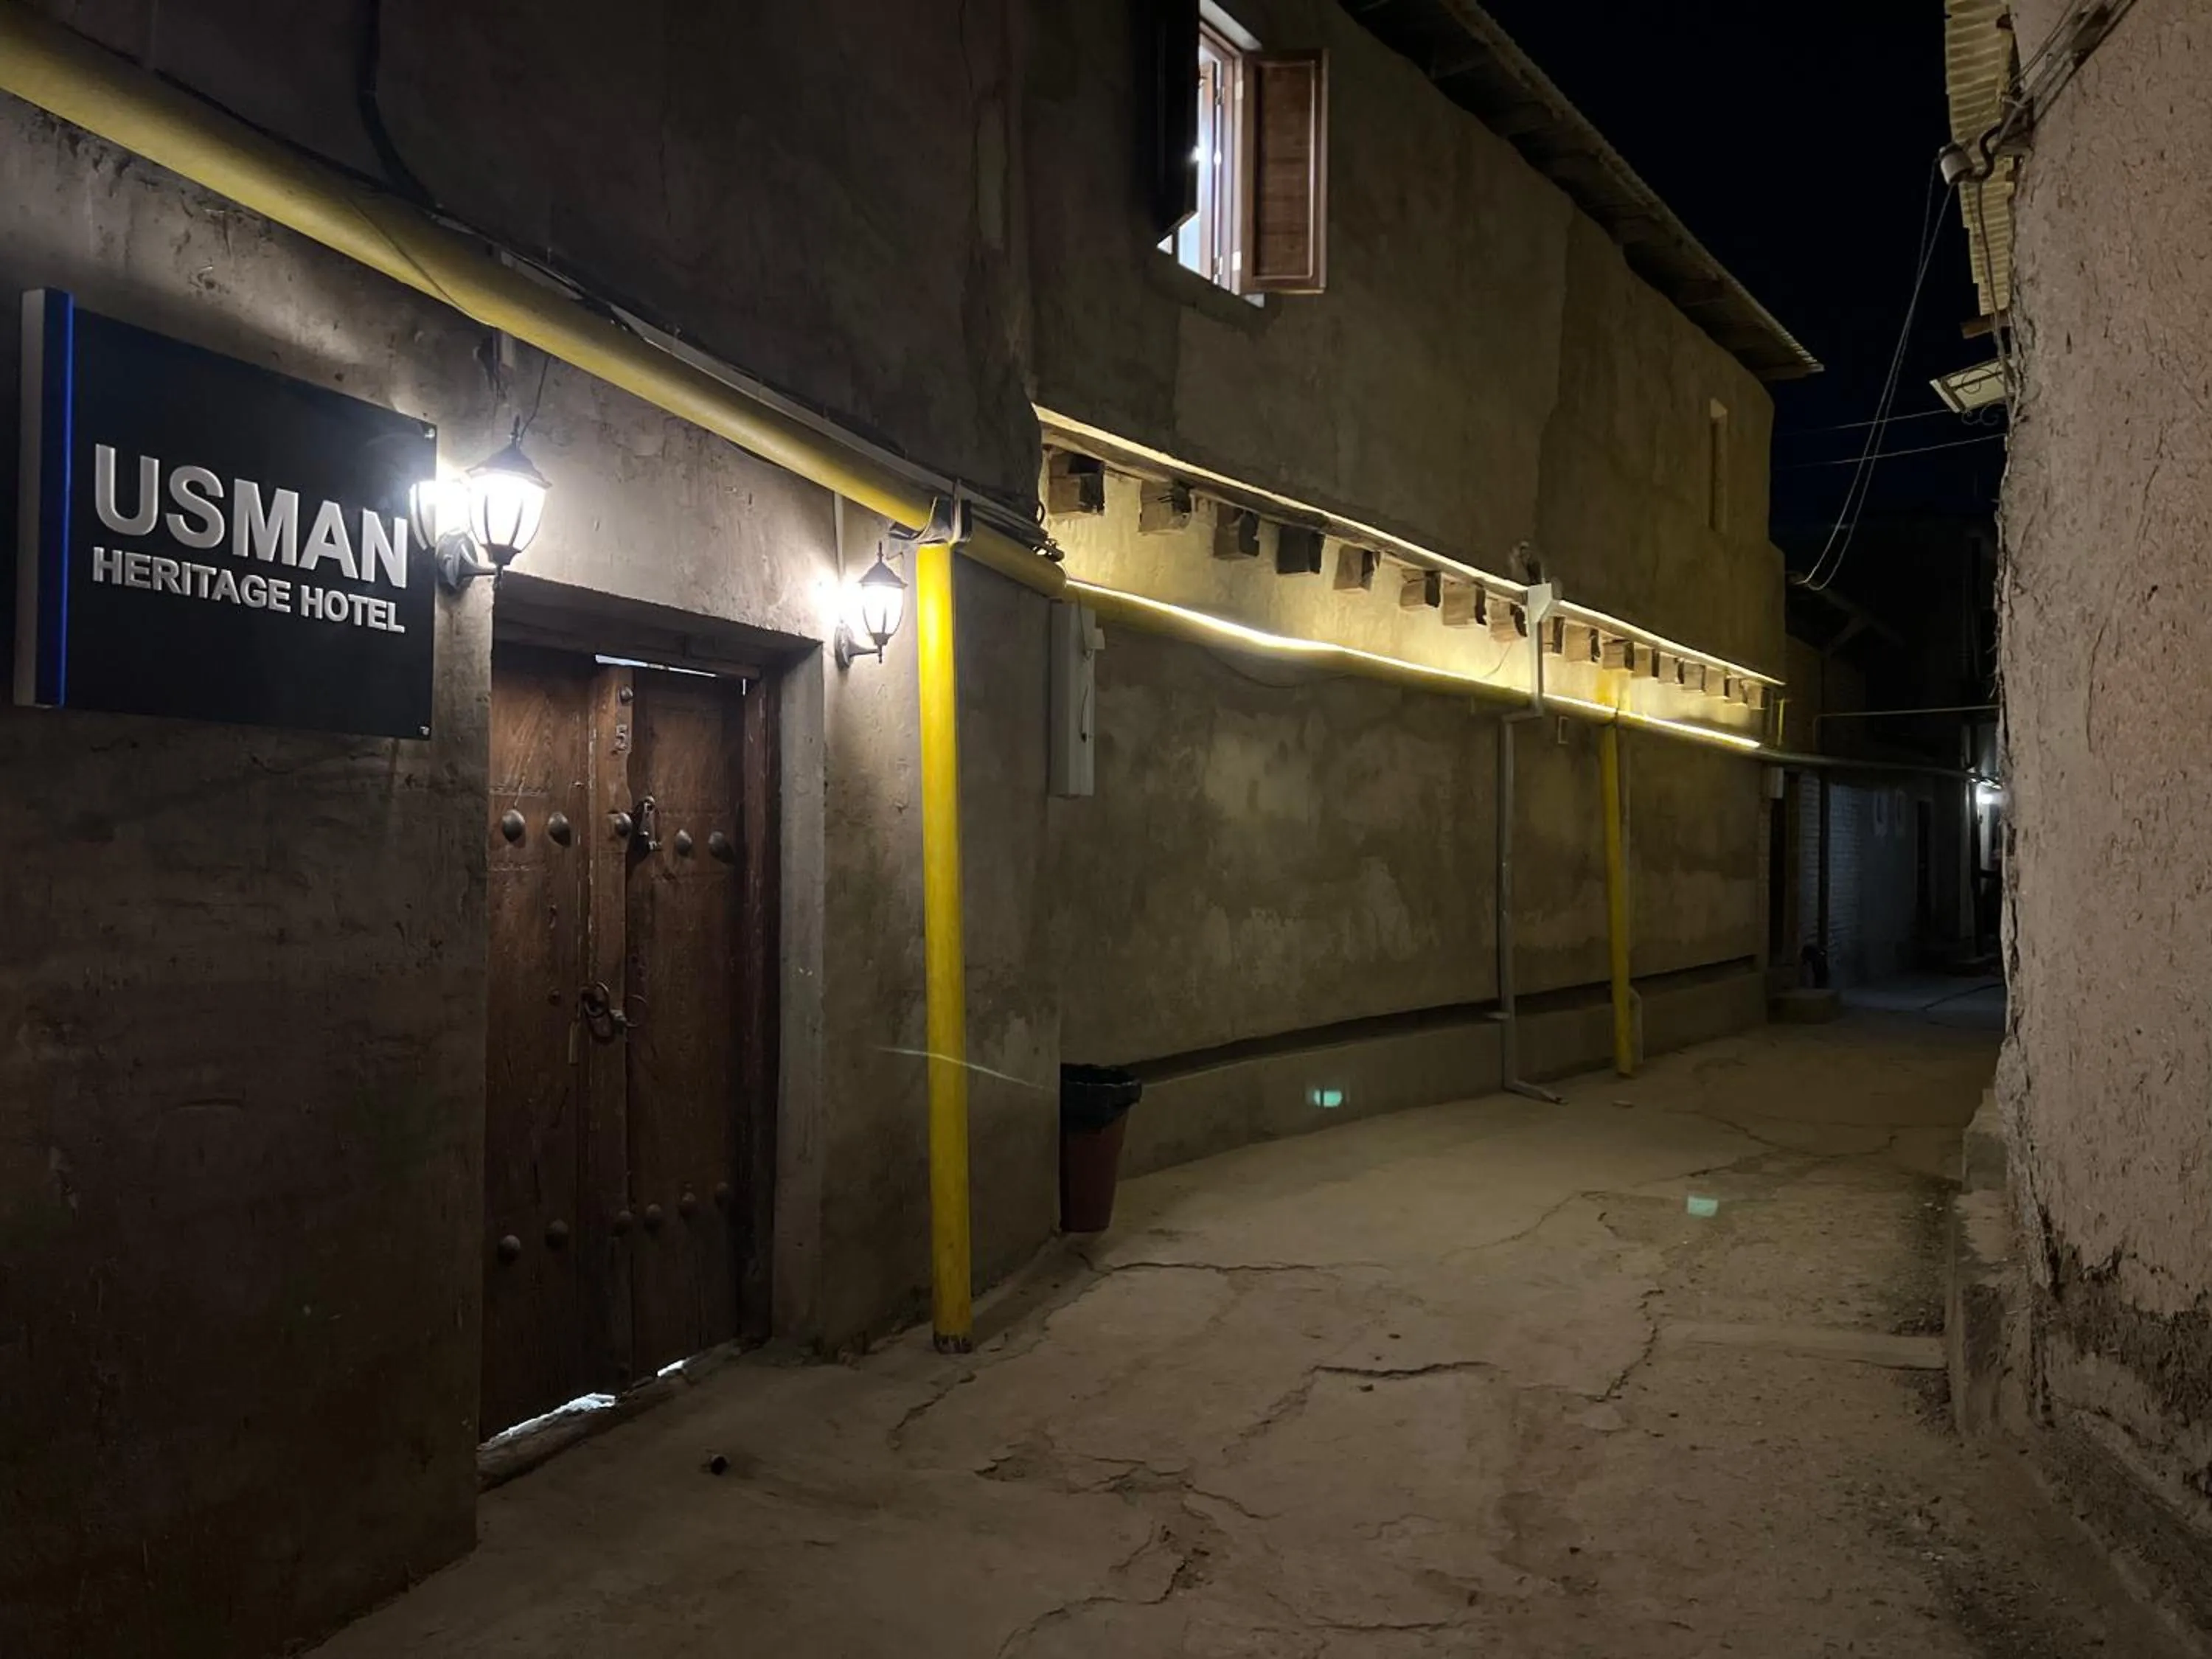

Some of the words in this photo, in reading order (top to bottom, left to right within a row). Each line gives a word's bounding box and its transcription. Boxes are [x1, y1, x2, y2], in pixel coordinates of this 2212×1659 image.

[95, 443, 408, 588] USMAN
[92, 546, 291, 613] HERITAGE
[300, 585, 406, 634] HOTEL
